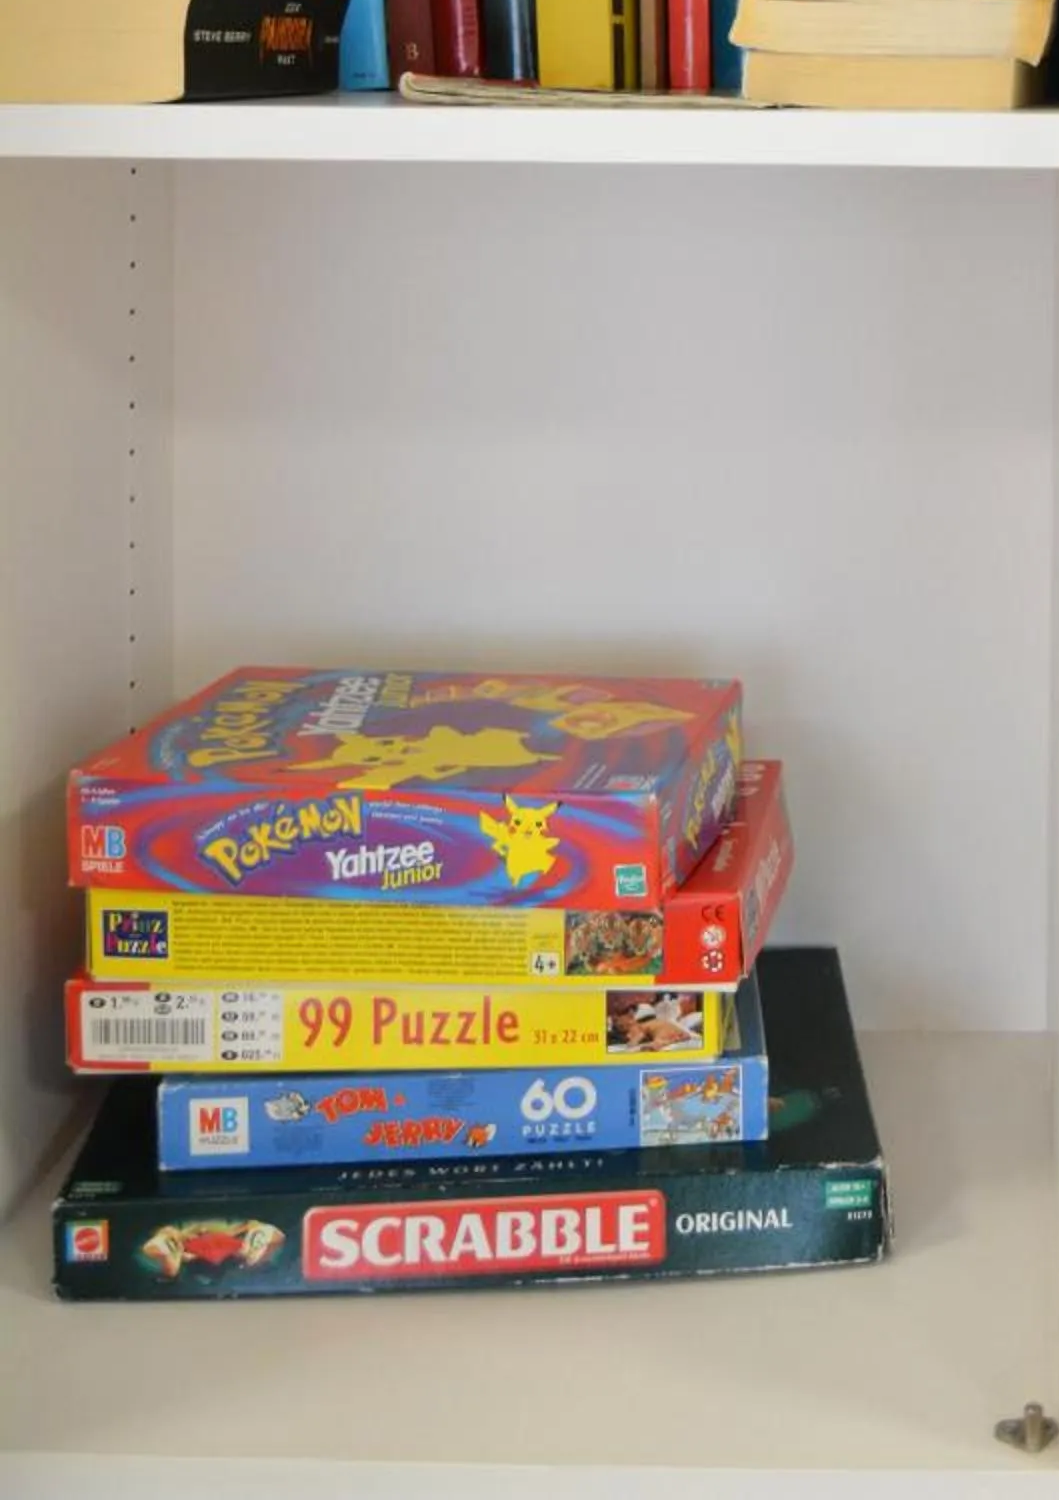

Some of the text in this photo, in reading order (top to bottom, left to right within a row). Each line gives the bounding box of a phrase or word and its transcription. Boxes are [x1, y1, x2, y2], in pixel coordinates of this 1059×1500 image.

[296, 676, 380, 737] Yahtzee
[80, 824, 127, 860] MB
[201, 795, 364, 882] Pokémon
[80, 860, 125, 873] SPIELE
[325, 840, 436, 881] Yahtzee
[380, 862, 444, 890] Junior
[104, 932, 168, 957] Puzzle
[298, 997, 355, 1049] 99
[371, 996, 522, 1049] Puzzle
[562, 1030, 599, 1043] 22 cm
[315, 1087, 389, 1123] TOM
[520, 1076, 598, 1121] 60
[198, 1107, 239, 1133] MB
[364, 1116, 466, 1148] JERRY
[521, 1121, 597, 1136] PUZZLE
[339, 1164, 500, 1181] JEDES WORT
[317, 1200, 653, 1270] SCRABBLE
[674, 1207, 794, 1236] ORIGINAL
